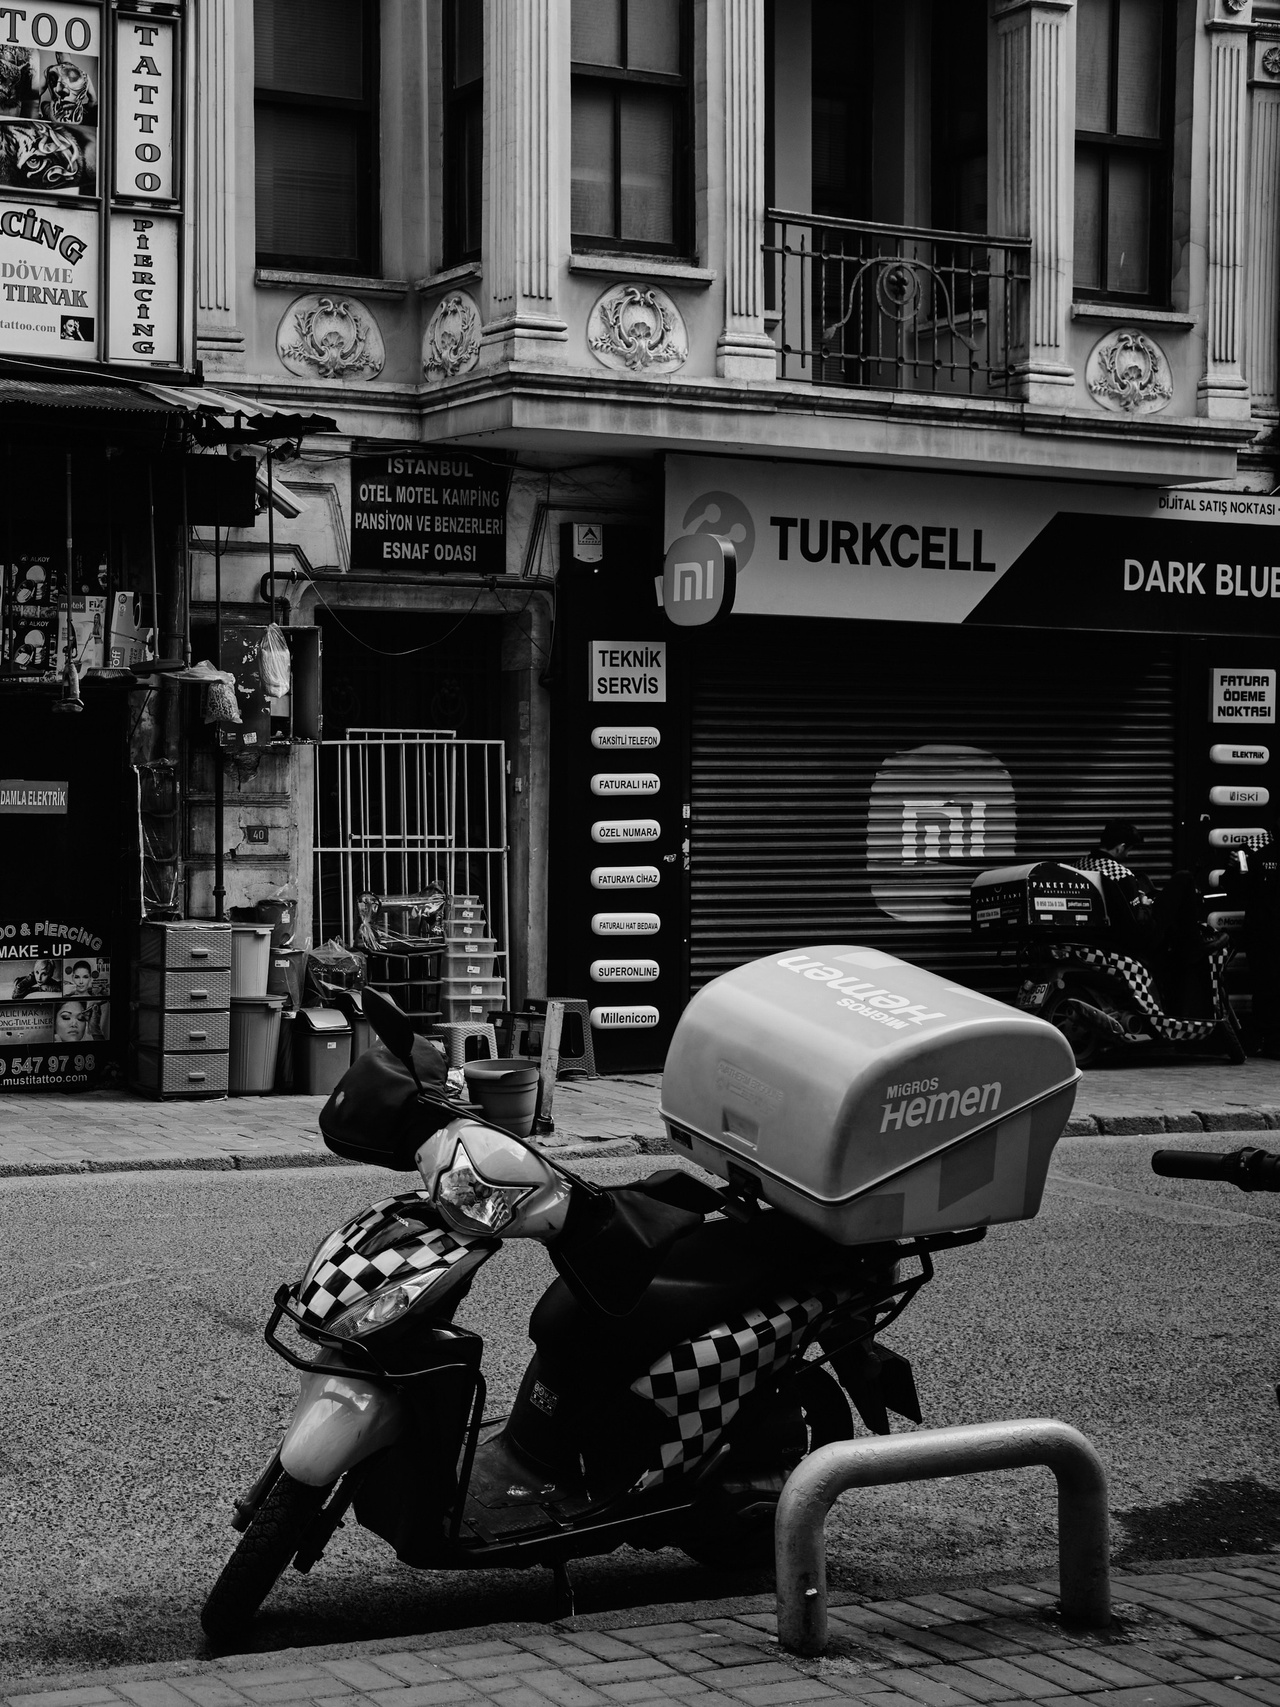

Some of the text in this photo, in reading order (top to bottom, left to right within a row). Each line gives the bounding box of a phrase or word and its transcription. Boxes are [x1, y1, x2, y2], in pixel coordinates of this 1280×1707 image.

[132, 25, 162, 192] TATTOO
[1, 260, 73, 284] DÖVME
[3, 282, 89, 308] TIRNAK
[359, 483, 500, 508] OTEL MOTEL KAMPİNG
[1158, 495, 1276, 516] DİJİTAL SATIŞ NOKTASI
[355, 509, 504, 535] PANSİYON VE BENZERLERİ
[382, 541, 477, 562] ESNAF ODASI
[770, 515, 996, 573] TURKCELL
[1123, 558, 1280, 599] DARK BLUE
[60, 601, 84, 609] mtek
[598, 646, 662, 668] TEKNİK
[597, 673, 659, 694] SERVİS
[1220, 675, 1269, 687] FATURA
[1223, 688, 1266, 702] ÖDEME
[1218, 706, 1271, 717] NOKTASI
[598, 734, 658, 746] TAKSİTLİ TELEFON
[599, 780, 659, 789] FATURALI HAT
[0, 787, 66, 806] DAMLA ELEKTRİK
[252, 829, 265, 840] 40
[599, 826, 658, 838] ÖZEL NUMARA
[598, 873, 658, 884] FATURAYA CİHAZ
[1032, 881, 1090, 890] PAKET TAXI
[19, 922, 31, 936] &
[599, 921, 658, 930] FATURALI HAT BEDAVA
[52, 943, 72, 957] UP
[598, 967, 658, 977] SUPERONLINE
[777, 955, 947, 1026] Hemen
[600, 1012, 657, 1024] Millenicom
[11, 1056, 44, 1075] 547
[48, 1055, 70, 1073] 97
[74, 1053, 96, 1072] 98
[880, 1081, 1002, 1134] Hemen
